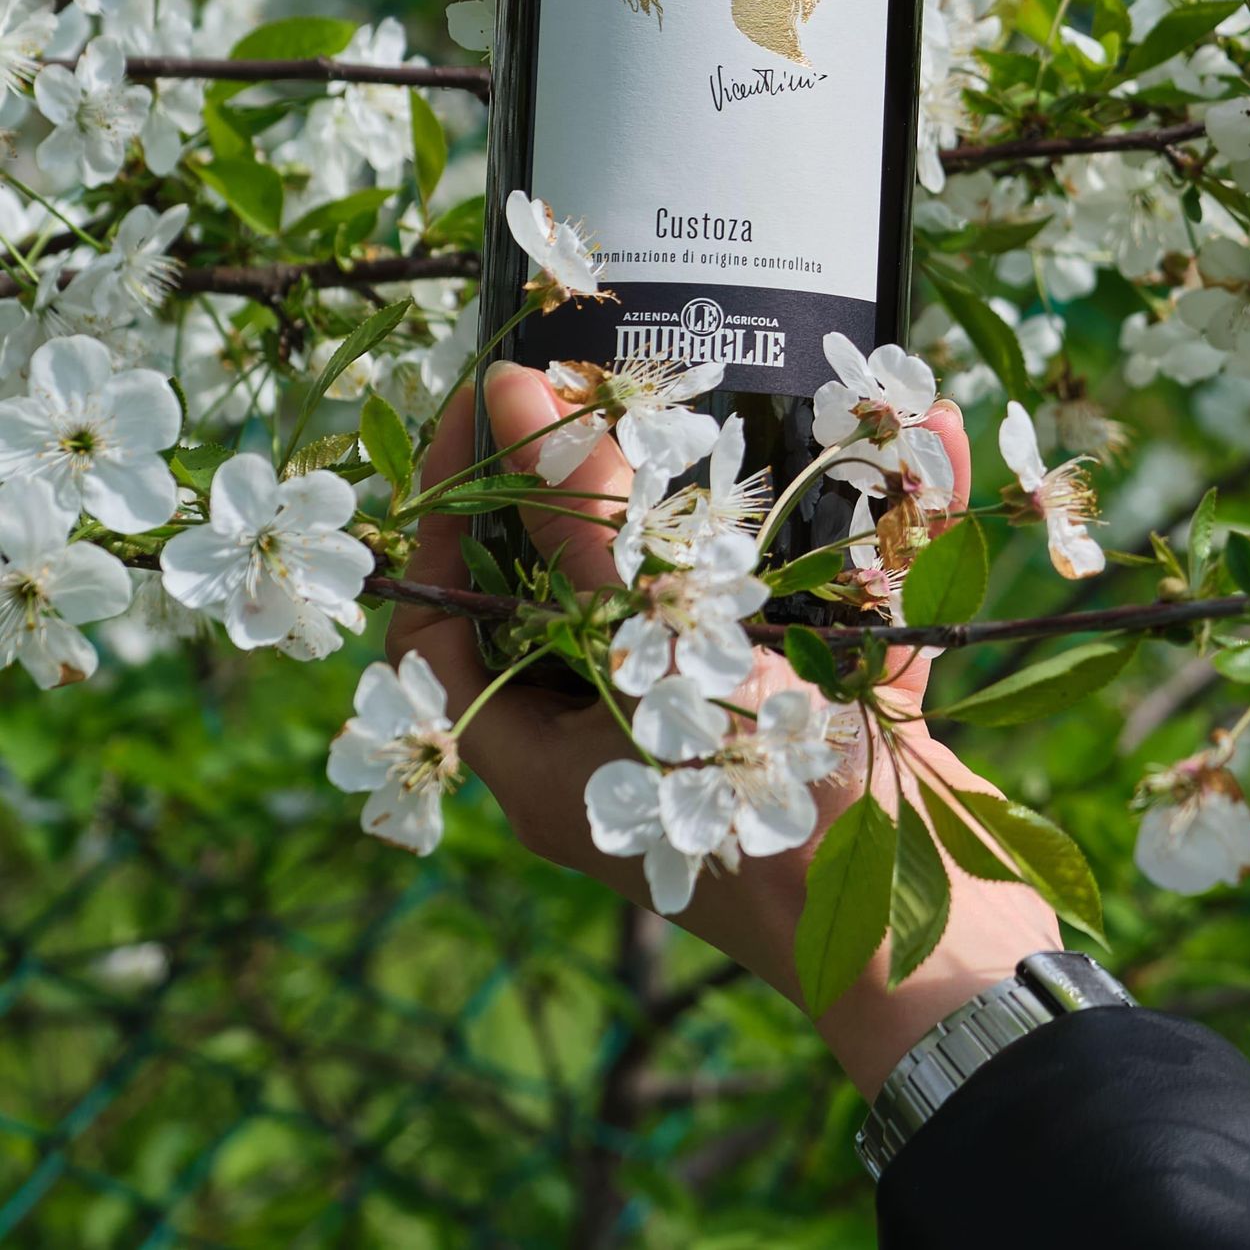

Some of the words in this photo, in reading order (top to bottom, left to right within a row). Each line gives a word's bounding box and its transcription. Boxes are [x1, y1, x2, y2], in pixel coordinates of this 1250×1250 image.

[655, 207, 753, 243] Custoza
[682, 250, 694, 264] di
[701, 252, 748, 269] origine
[753, 256, 823, 274] controllata
[623, 311, 680, 323] AZIENDA
[687, 305, 719, 333] LE
[725, 315, 780, 328] AGRICOLA
[613, 325, 786, 368] MURAGLIE
